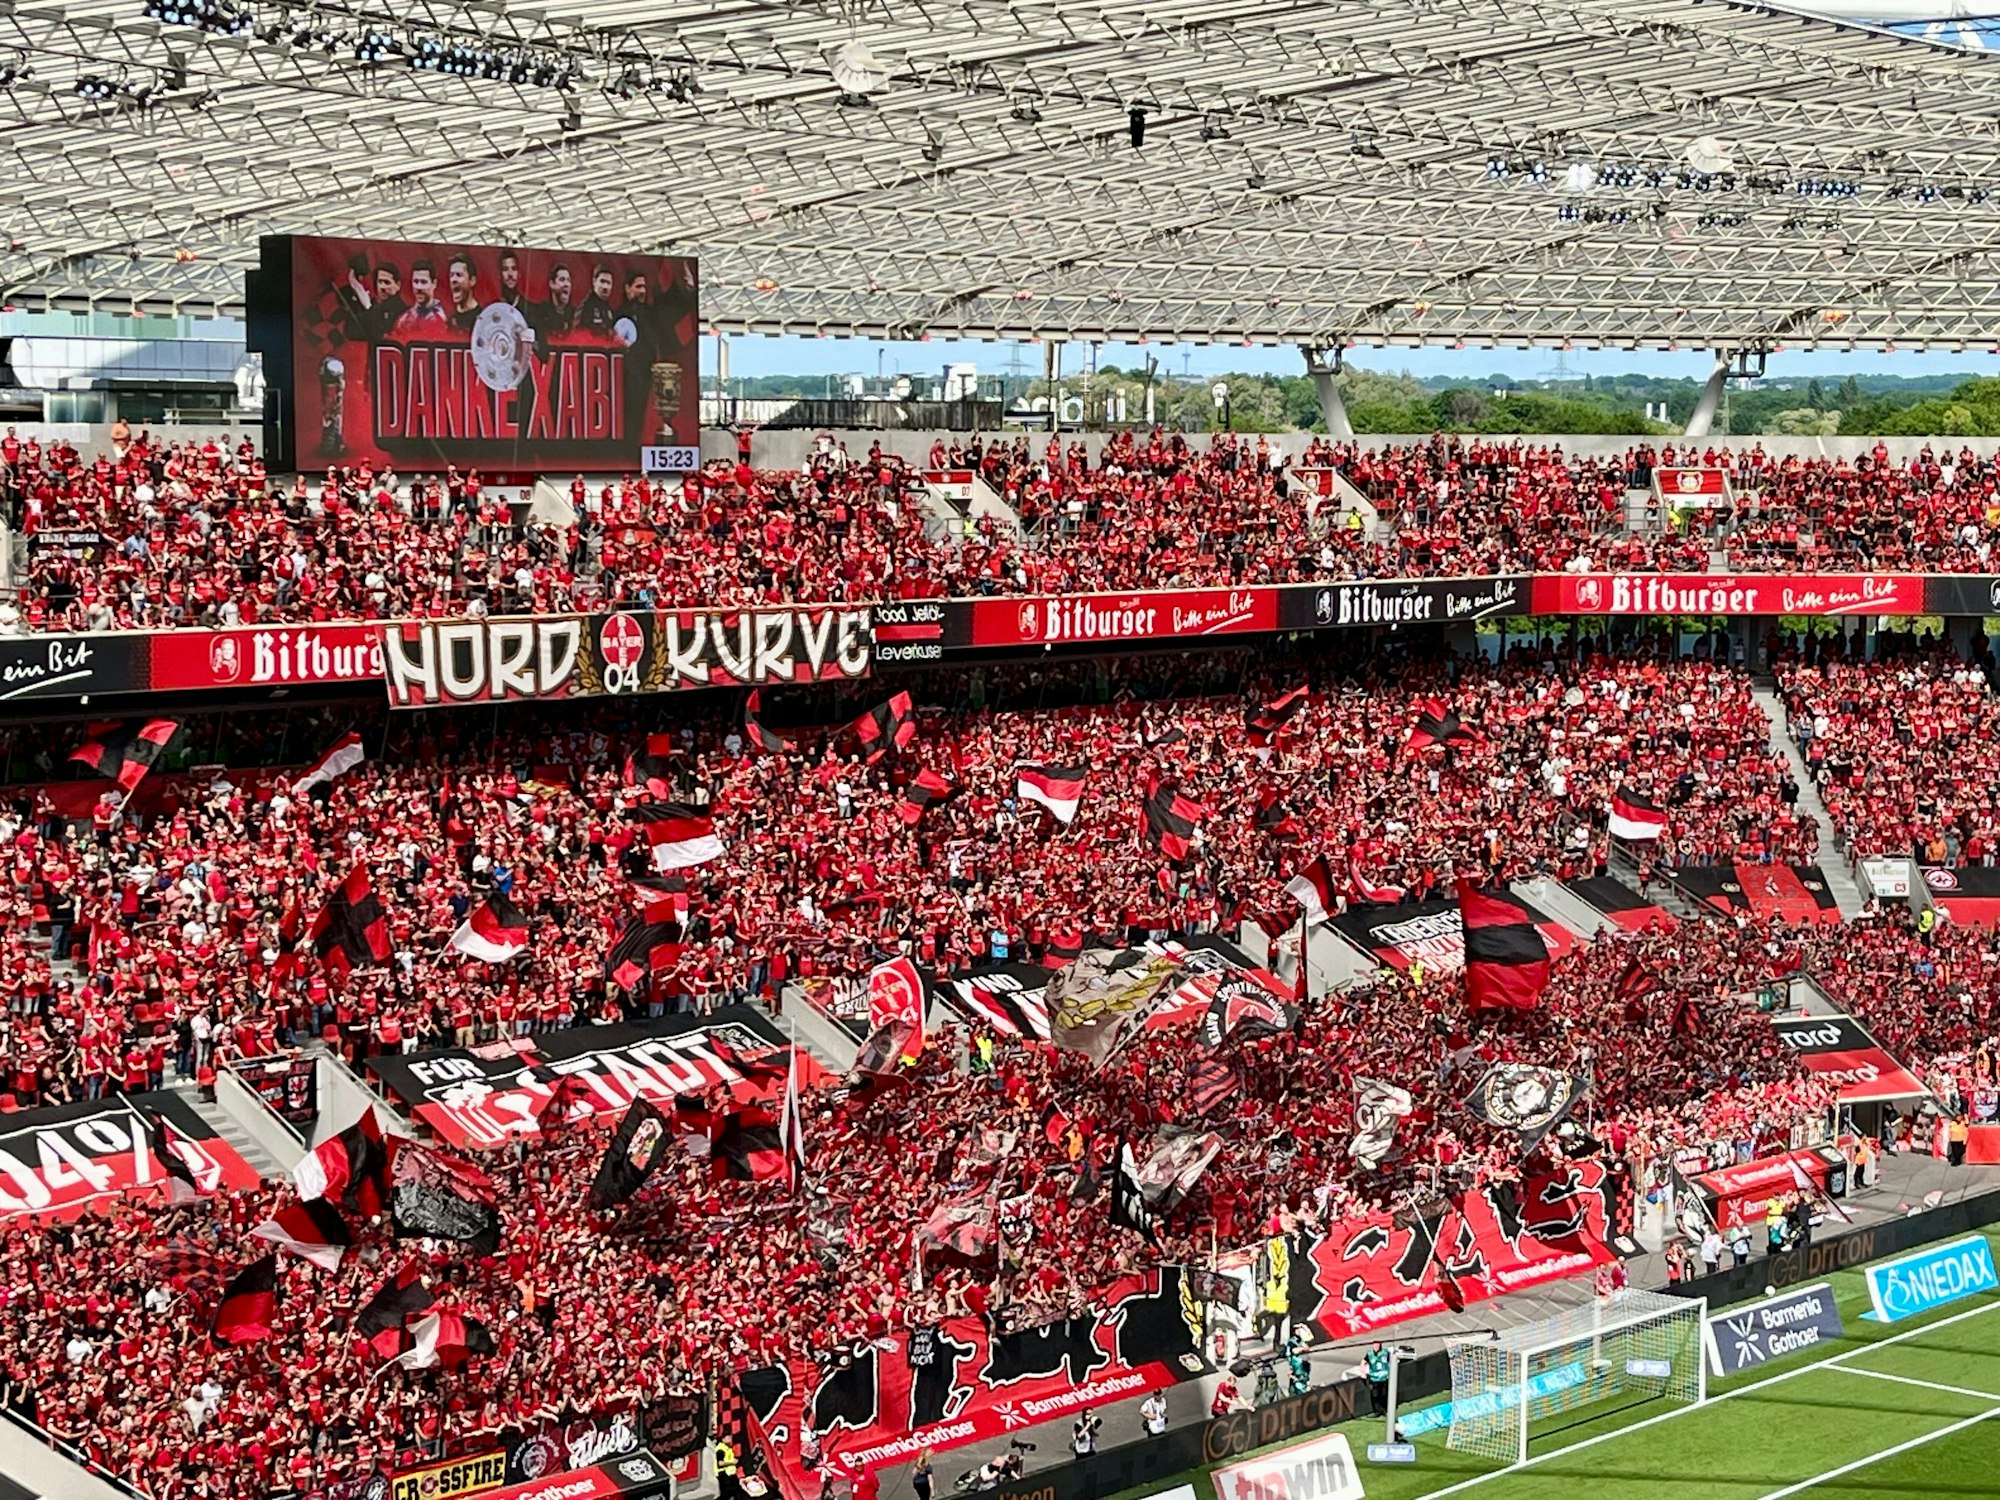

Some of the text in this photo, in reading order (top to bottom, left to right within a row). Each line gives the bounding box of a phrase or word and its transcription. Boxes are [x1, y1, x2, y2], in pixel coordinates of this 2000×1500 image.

[376, 346, 625, 439] DANKE XABI
[650, 450, 693, 469] 15:23
[1173, 592, 1255, 633] Bitte ein Bit
[1337, 587, 1433, 625] Bitburger
[1446, 580, 1516, 618] Bitte ein Bit
[1610, 578, 1759, 612] Bitburger
[1783, 577, 1898, 612] Bitte ein Bit
[1044, 599, 1158, 640] Bitburger
[2, 640, 94, 683] ein Bit
[384, 620, 582, 704] NORD
[602, 635, 643, 649] BAYER
[665, 609, 870, 682] KURVE
[603, 661, 641, 695] 04
[407, 1057, 486, 1086] FÜR
[1807, 1230, 1876, 1277] DITCON
[1907, 1246, 1994, 1308] NIEDAX
[1761, 1295, 1823, 1331] Barmenia
[1767, 1325, 1821, 1357] Gothaer
[1024, 1370, 1147, 1416] BarmeniaGothaer
[1261, 1384, 1356, 1442] DITCON
[839, 1419, 977, 1469] BarmeniaGothaer
